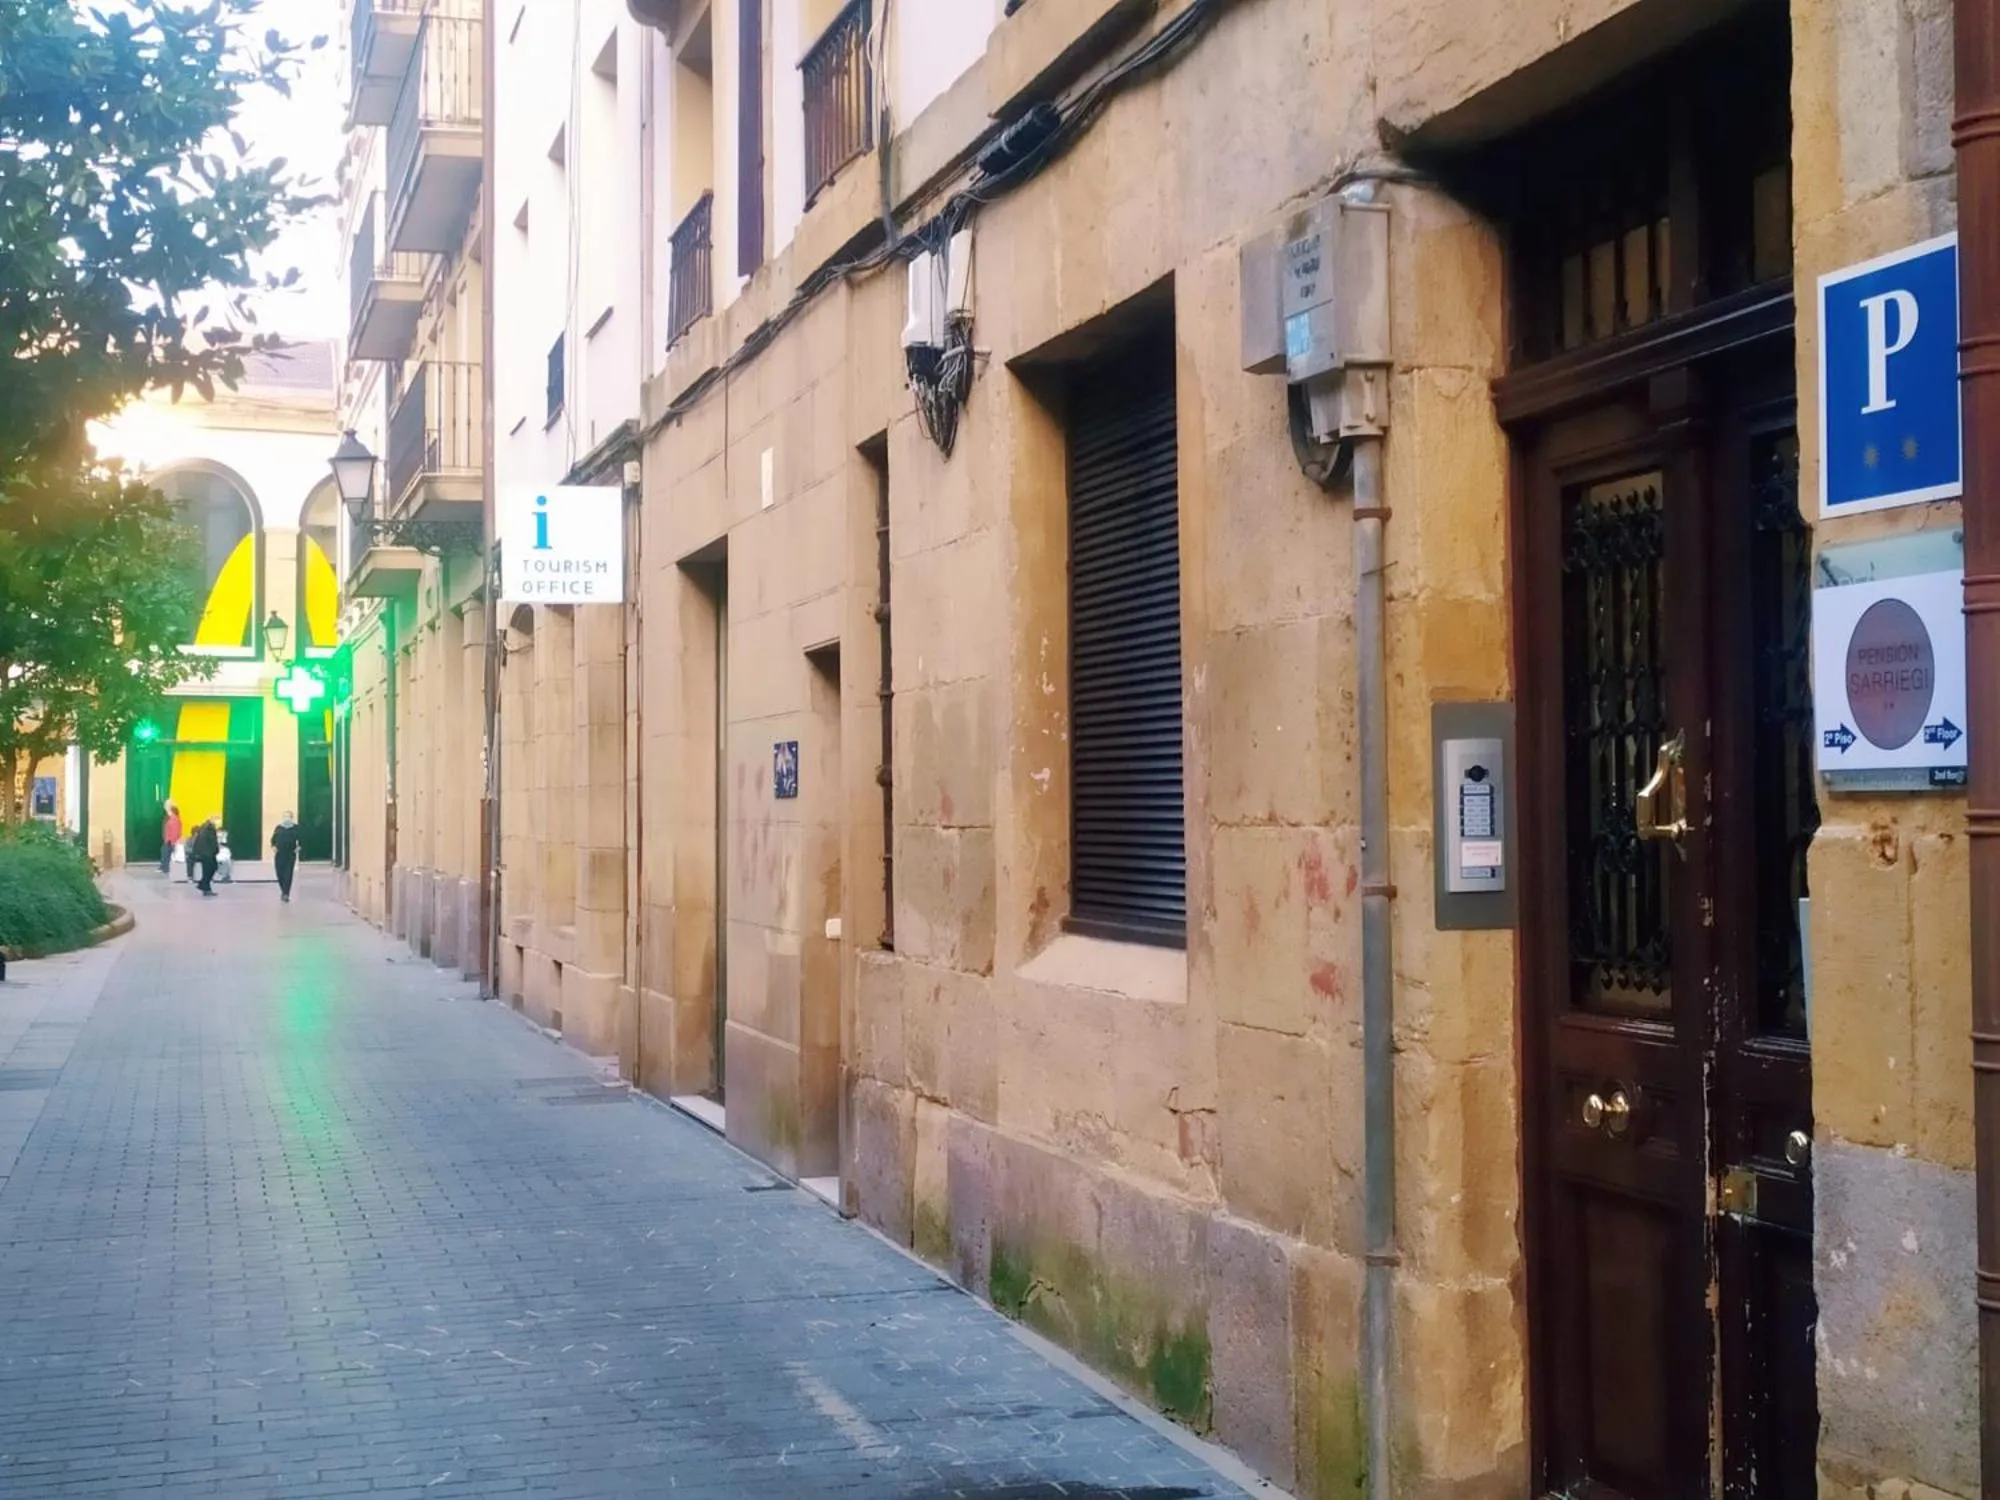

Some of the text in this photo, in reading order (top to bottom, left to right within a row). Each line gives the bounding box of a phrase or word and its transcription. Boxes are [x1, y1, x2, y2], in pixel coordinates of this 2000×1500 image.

[1859, 289, 1919, 415] P
[531, 495, 553, 550] i
[522, 559, 608, 573] TOURISM
[521, 580, 594, 595] OFFICE
[1850, 668, 1929, 695] SARRIEGI
